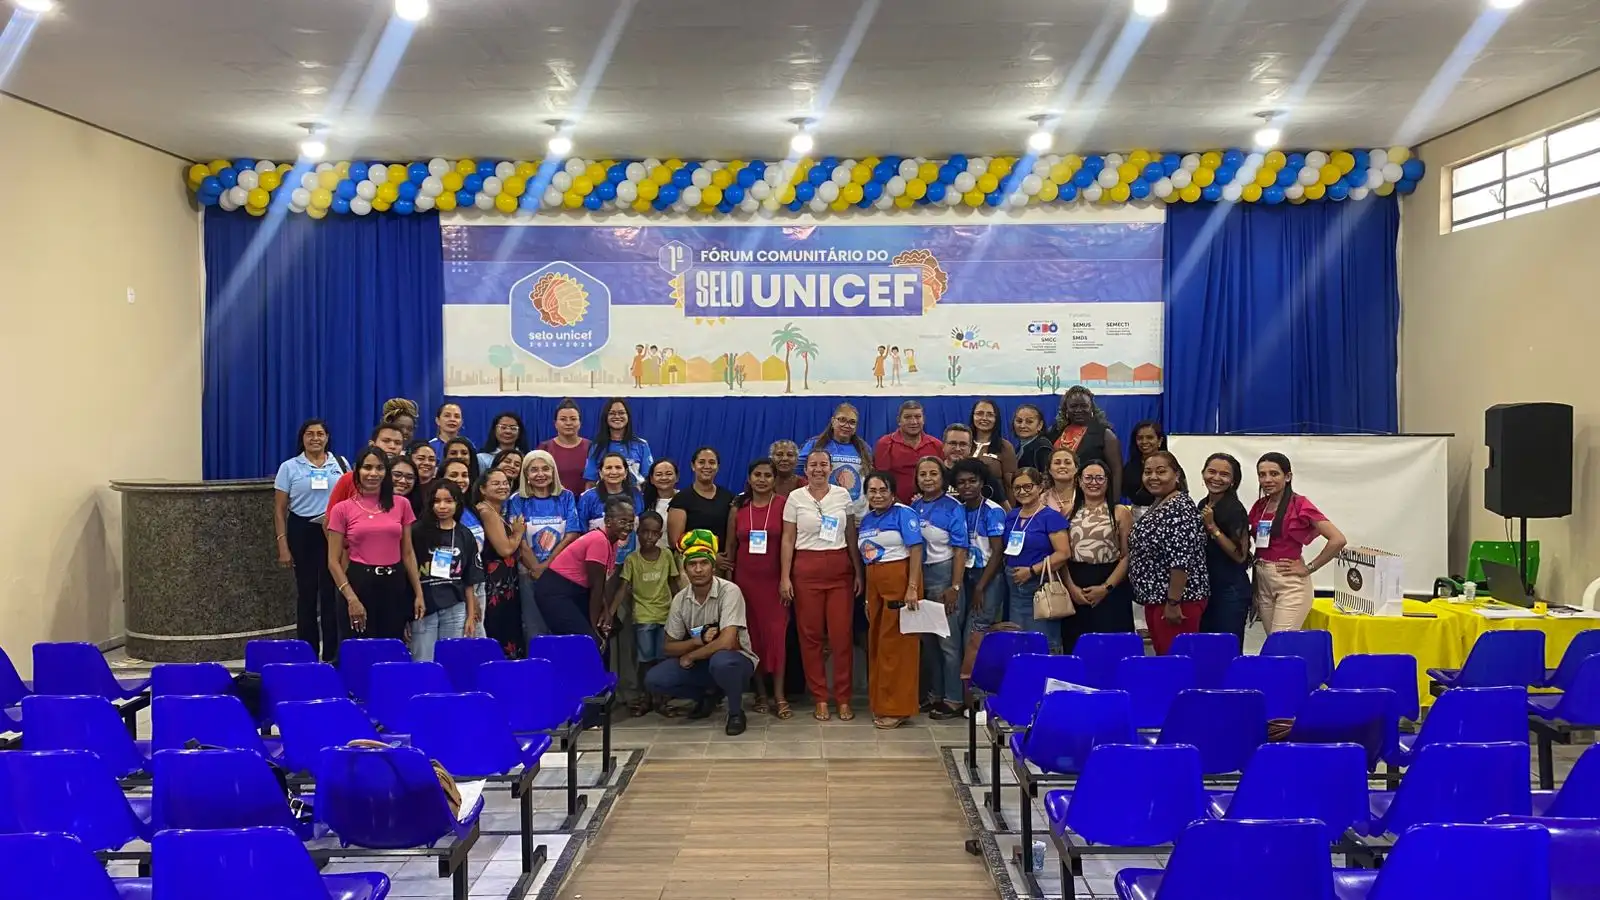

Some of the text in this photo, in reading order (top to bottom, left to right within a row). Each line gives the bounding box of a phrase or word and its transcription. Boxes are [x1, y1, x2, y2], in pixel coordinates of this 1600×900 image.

[701, 247, 888, 262] FÓRUM COMUNITÁRIO DO
[696, 270, 918, 308] SELO UNICEF
[529, 329, 592, 340] selo unicef
[962, 339, 1000, 350] CMDCA
